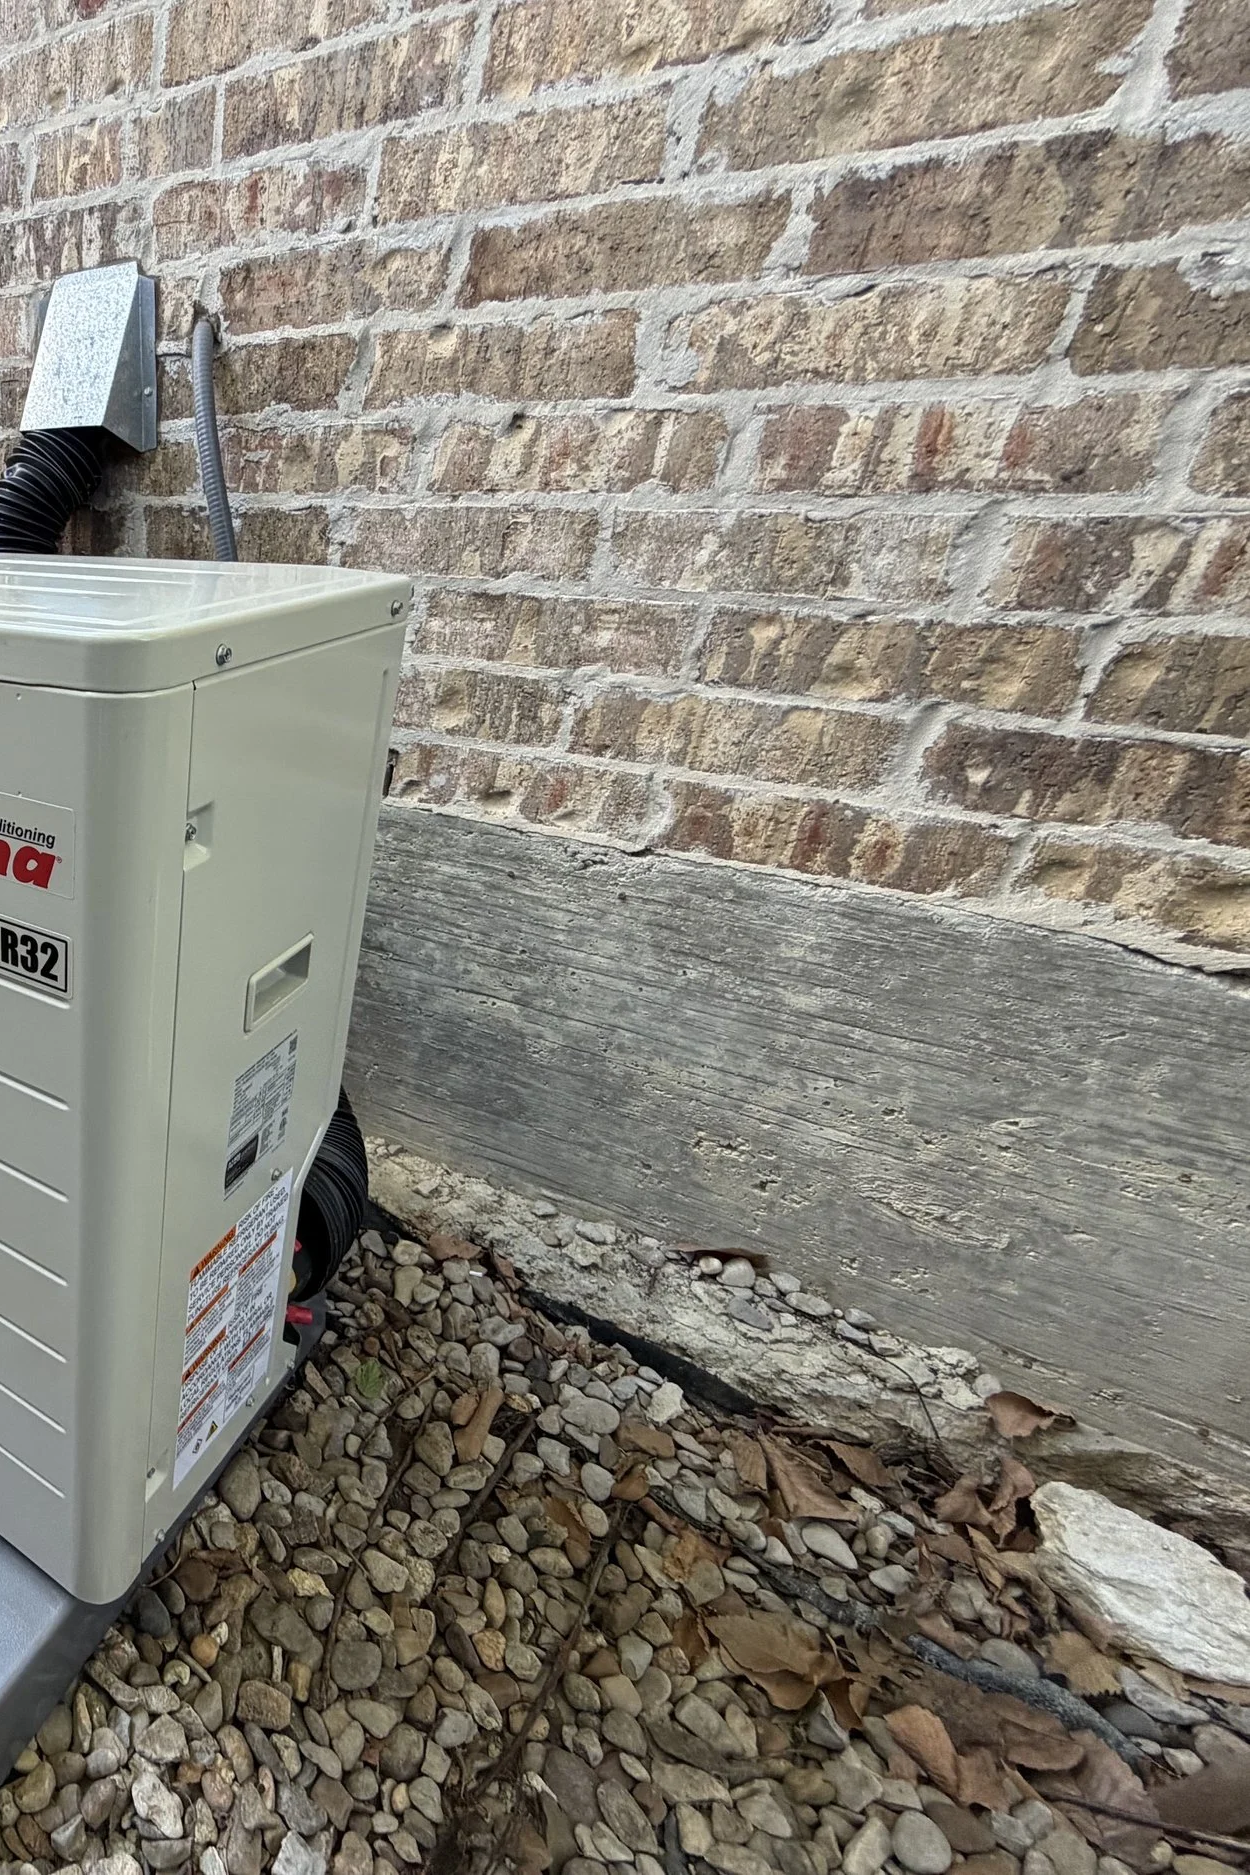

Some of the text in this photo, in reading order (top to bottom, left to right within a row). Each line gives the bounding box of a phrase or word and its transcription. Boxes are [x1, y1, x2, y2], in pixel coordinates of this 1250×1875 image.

[0, 927, 59, 982] R32
[238, 1210, 253, 1228] RISK
[262, 1187, 275, 1204] FIRE
[240, 1228, 255, 1246] ONLY
[264, 1215, 276, 1230] NOT
